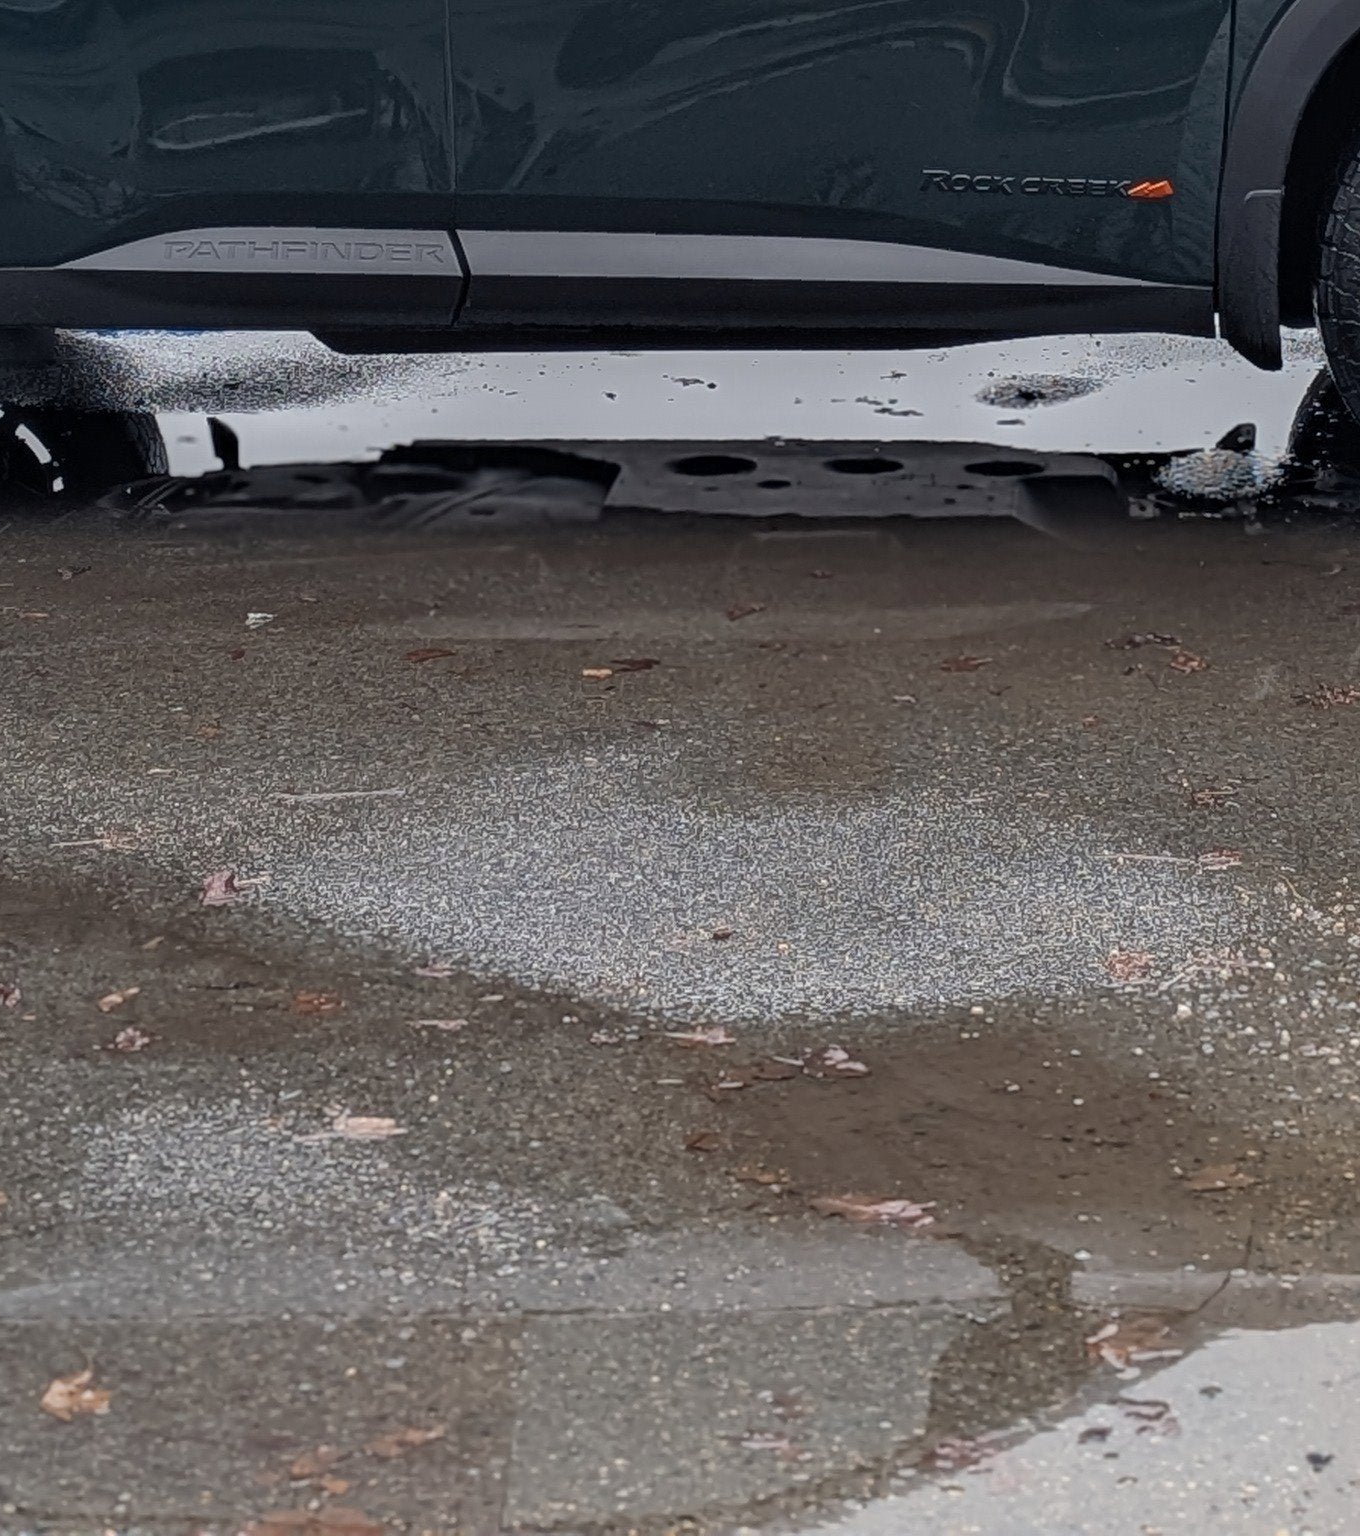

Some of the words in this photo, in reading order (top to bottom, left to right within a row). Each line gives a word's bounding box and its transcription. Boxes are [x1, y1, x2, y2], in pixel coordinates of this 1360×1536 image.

[919, 169, 1014, 194] ROCK
[1021, 177, 1131, 197] CREEK
[164, 240, 445, 264] PATHFINDER
